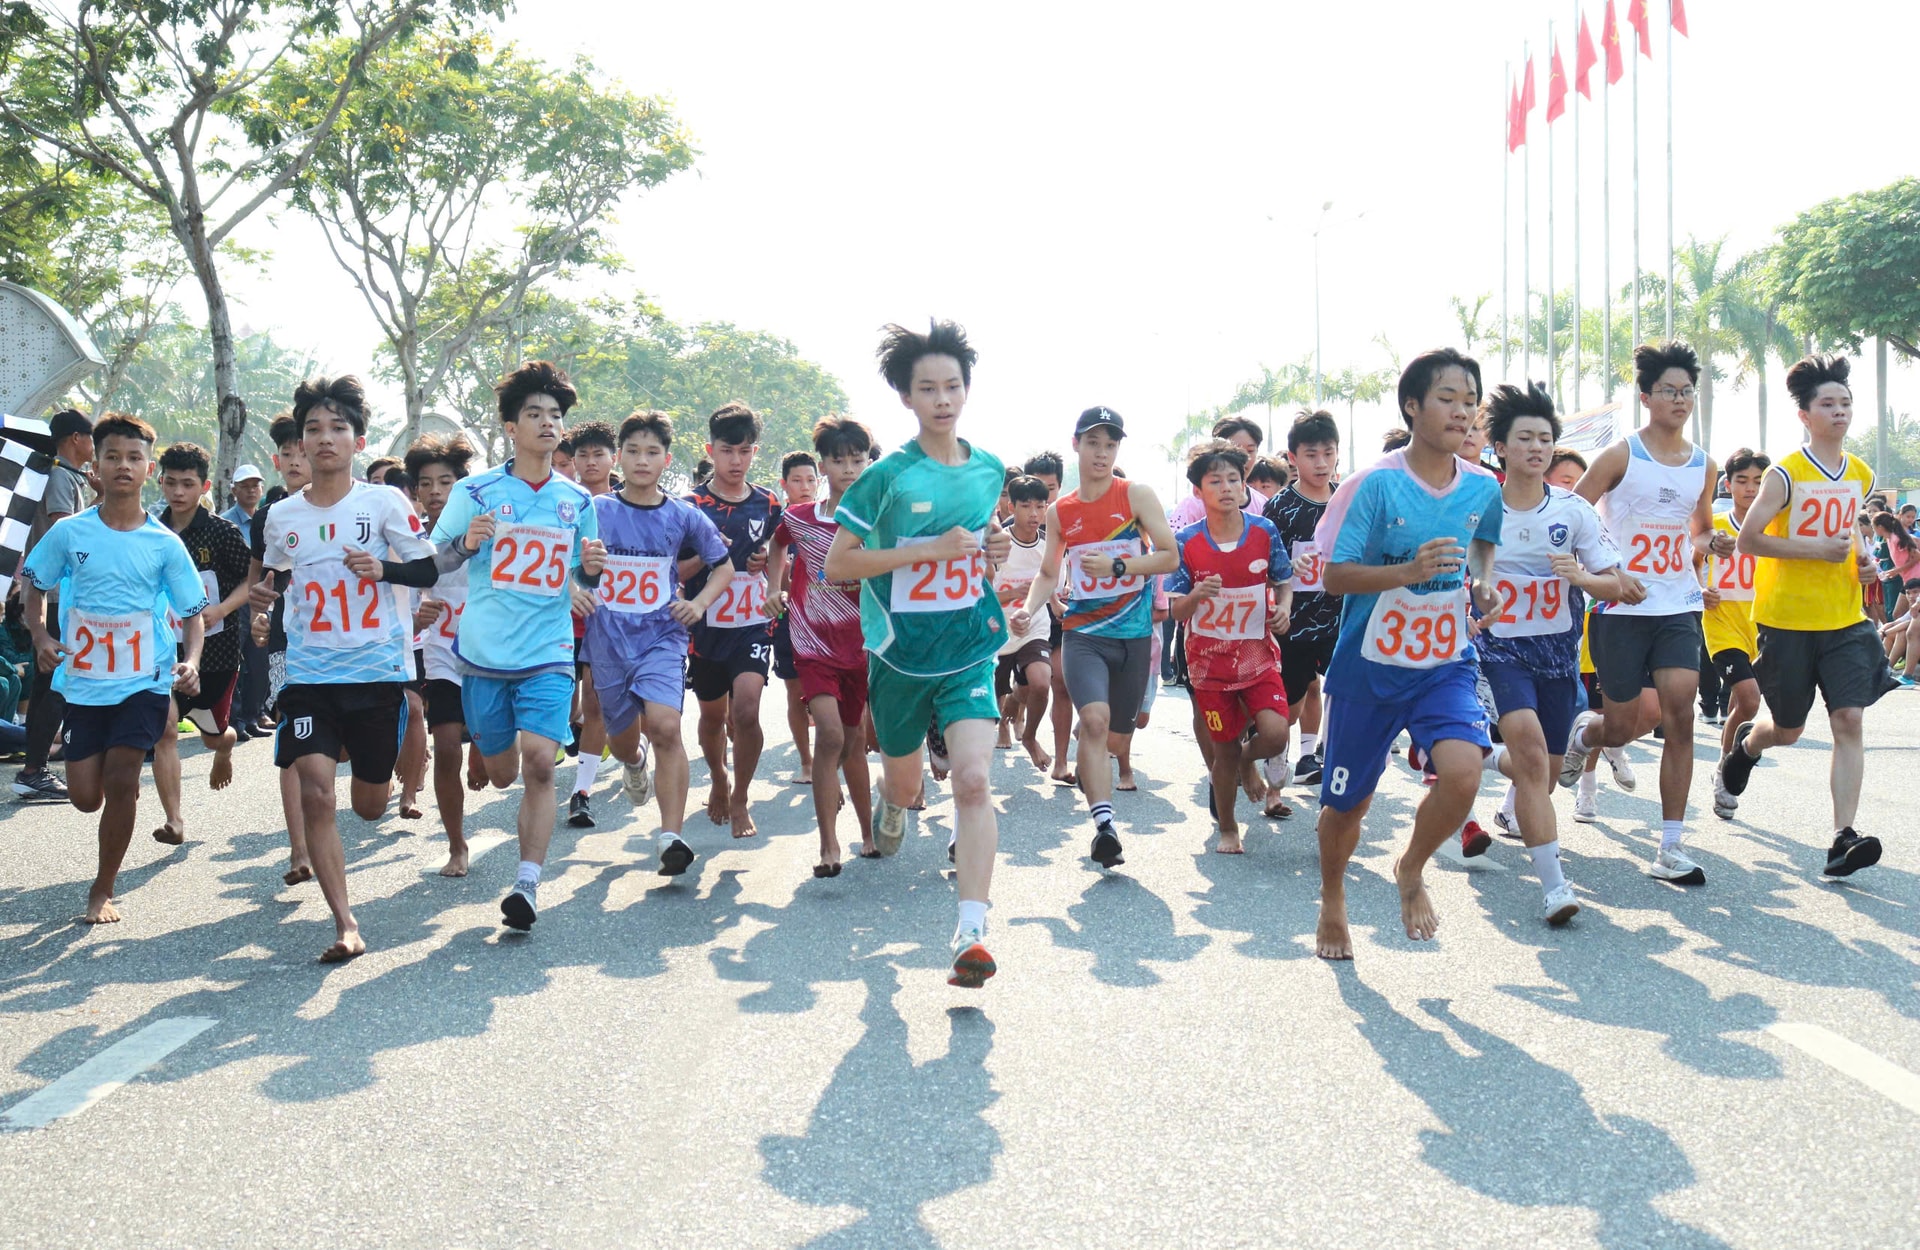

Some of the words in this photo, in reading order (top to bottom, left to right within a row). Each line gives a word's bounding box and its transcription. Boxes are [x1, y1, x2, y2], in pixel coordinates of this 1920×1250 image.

[1797, 497, 1857, 538] 204
[491, 536, 569, 589] 225
[909, 550, 984, 601] 255
[1300, 554, 1325, 586] 3
[1627, 533, 1685, 575] 238
[304, 577, 380, 632] 212
[598, 568, 659, 606] 326
[1495, 580, 1561, 624] 219
[1197, 598, 1257, 634] 247
[1376, 609, 1457, 662] 339
[73, 625, 142, 673] 211
[1329, 766, 1350, 796] 8
